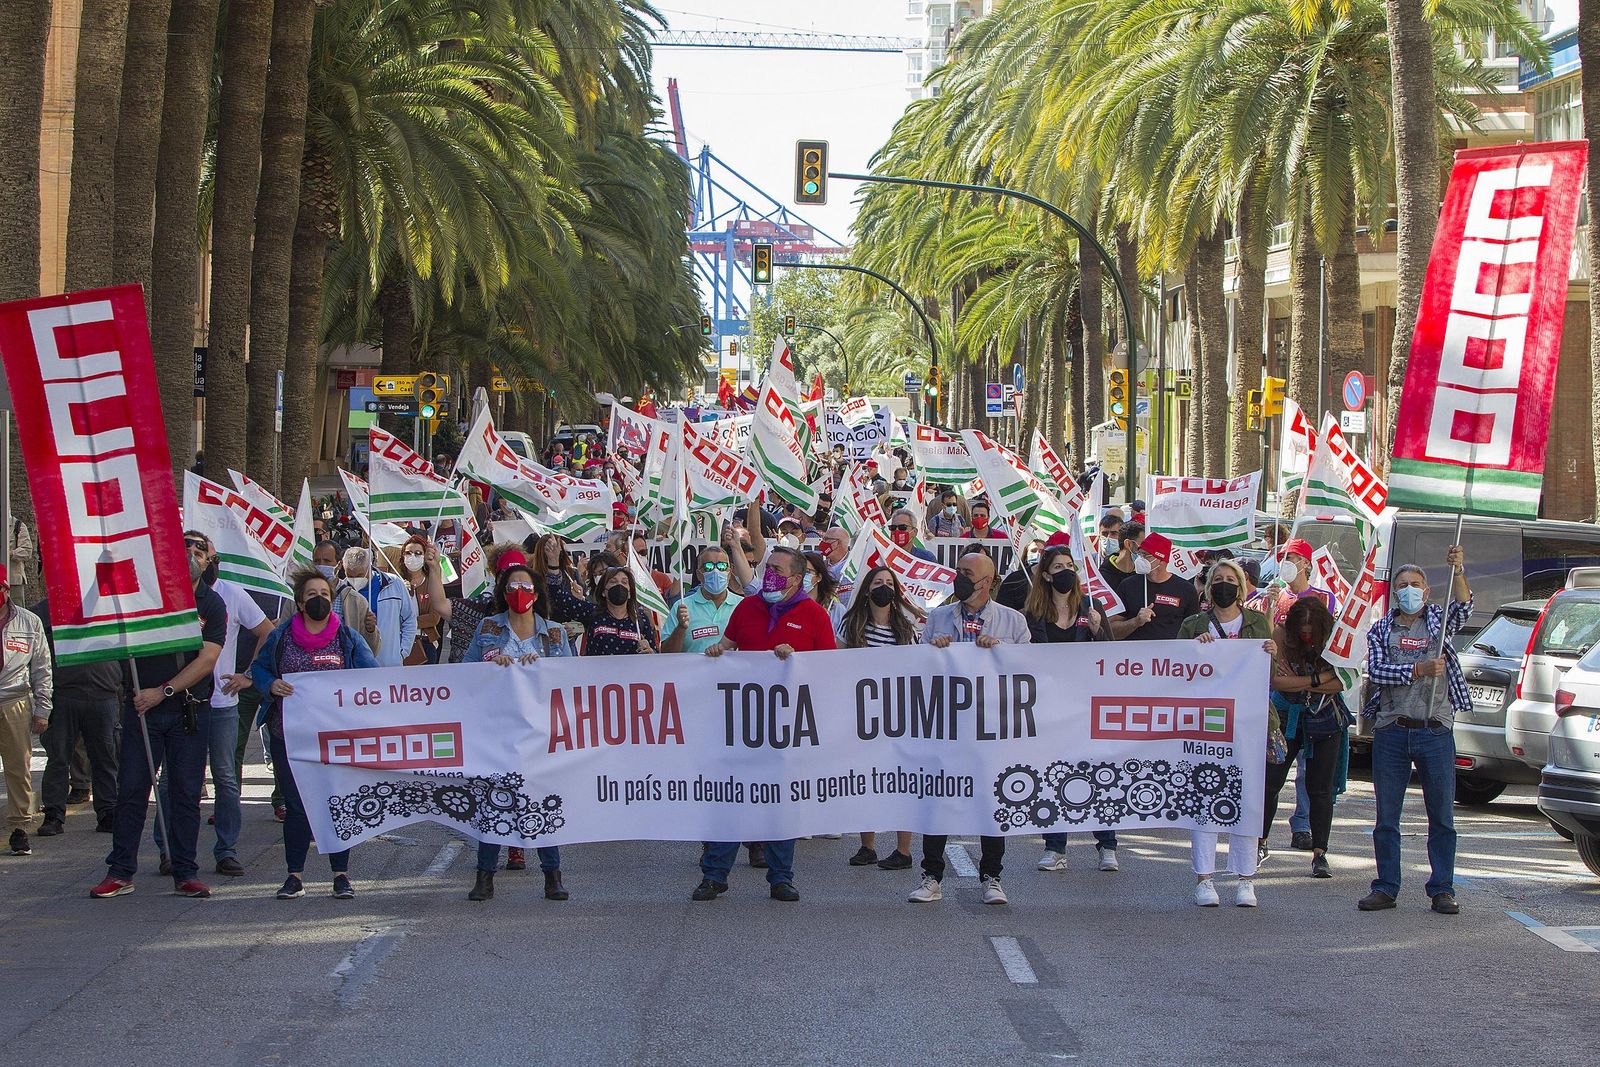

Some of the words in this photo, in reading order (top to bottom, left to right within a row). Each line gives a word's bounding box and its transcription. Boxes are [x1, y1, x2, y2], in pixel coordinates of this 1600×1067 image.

[1431, 164, 1553, 466] CCOO
[841, 399, 866, 415] CCOO
[27, 299, 164, 618] CCOO
[1199, 497, 1249, 510] Málaga
[1096, 658, 1105, 676] 1
[1115, 658, 1144, 676] de
[1151, 658, 1214, 682] Mayo
[334, 688, 343, 707] 1
[354, 687, 381, 706] de
[390, 684, 450, 706] Mayo
[1485, 688, 1503, 702] JTZ
[547, 682, 685, 753] AHORA
[717, 682, 820, 749] TOCA
[855, 673, 1037, 741] CUMPLIR
[1099, 705, 1200, 732] CCOO
[328, 733, 430, 764] CCOO
[1183, 741, 1233, 760] Málaga
[597, 775, 618, 802] Un
[625, 774, 661, 805] país
[668, 779, 687, 801] en
[693, 774, 744, 803] deuda
[751, 783, 780, 804] con
[791, 779, 810, 802] su
[817, 769, 866, 803] gente
[872, 766, 974, 799] trabajadora
